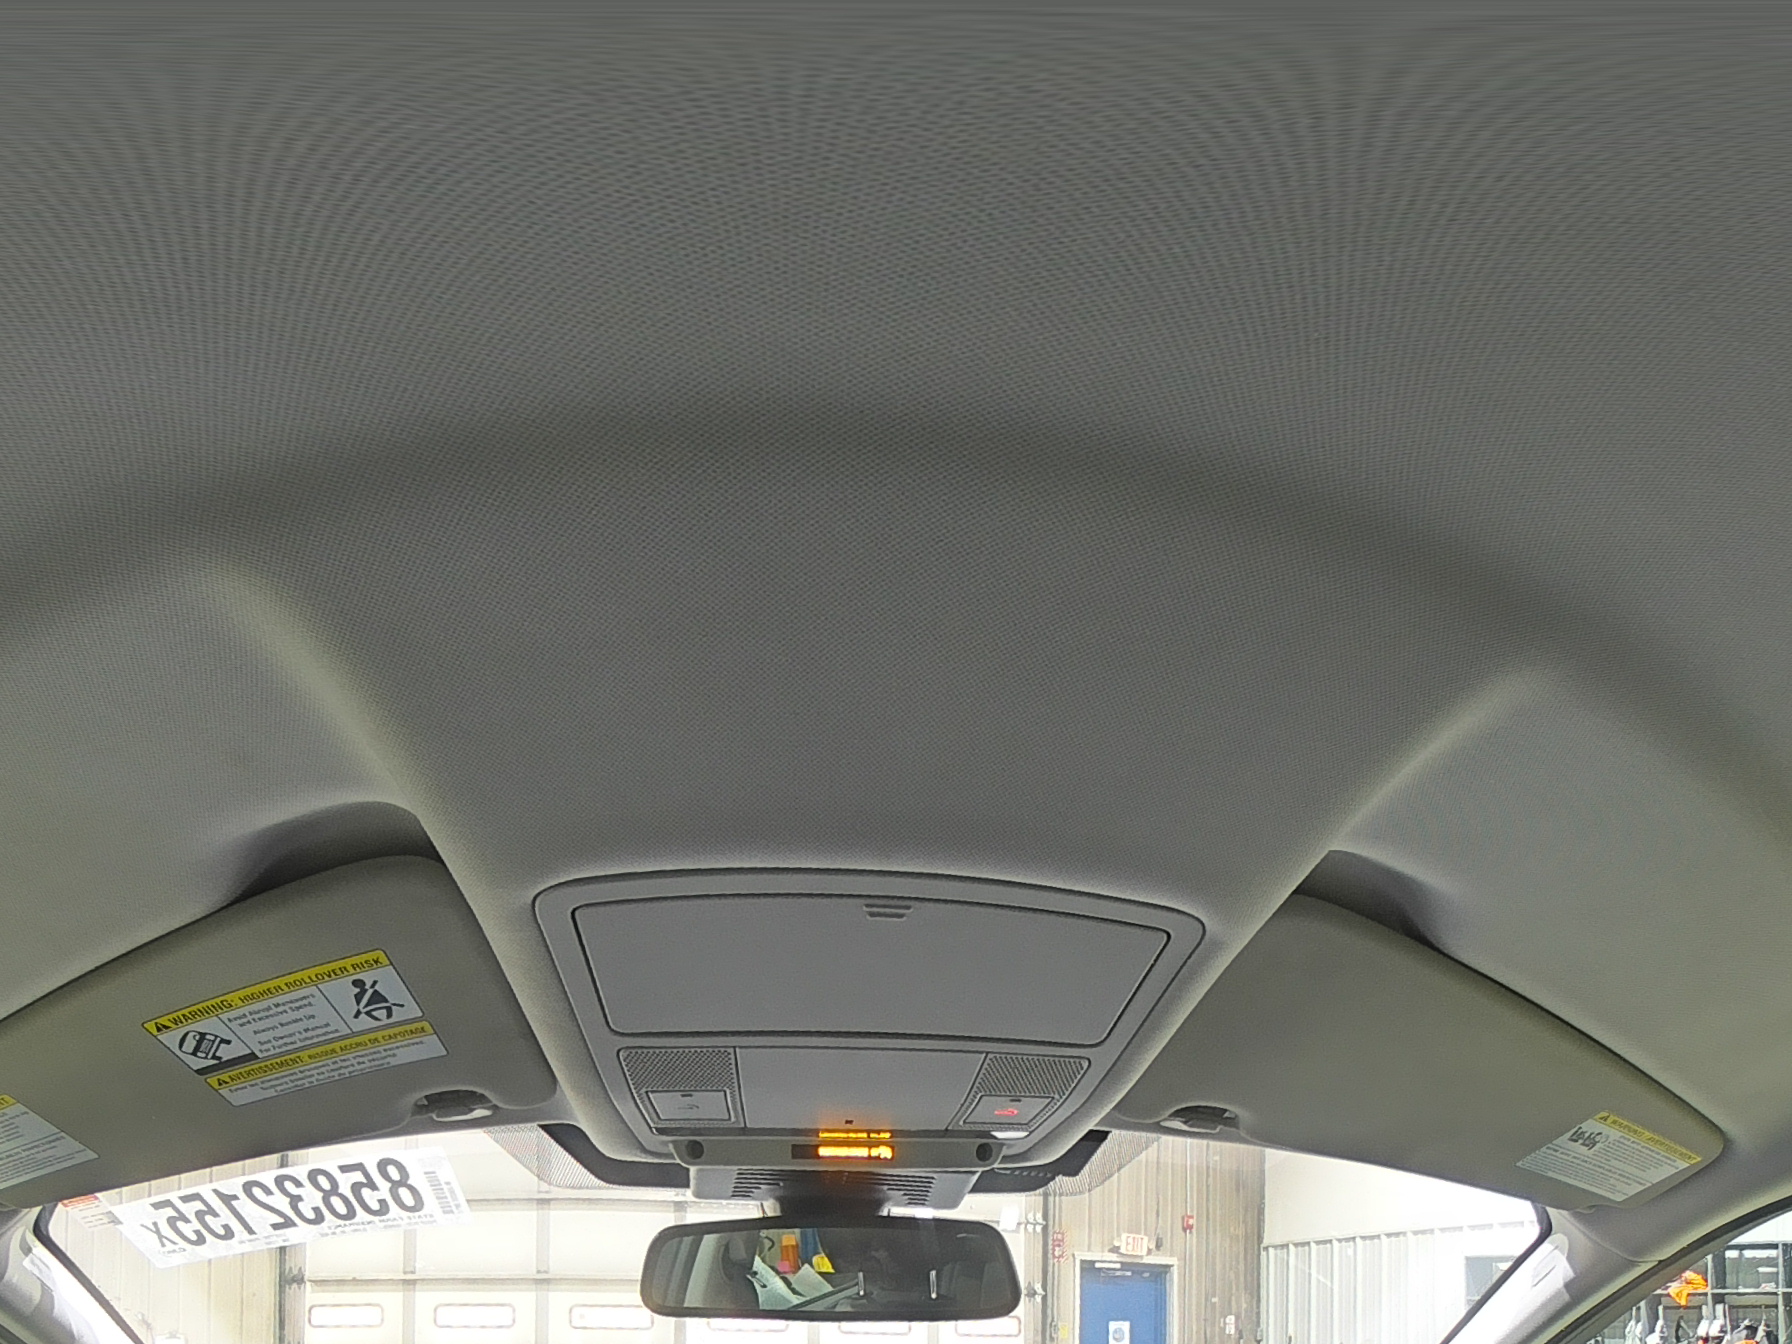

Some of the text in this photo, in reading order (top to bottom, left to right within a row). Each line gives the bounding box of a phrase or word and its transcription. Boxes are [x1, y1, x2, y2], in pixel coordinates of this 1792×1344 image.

[168, 956, 383, 1027] WARNING: HIGHER ROLLOVER RISK
[1125, 1235, 1144, 1253] EXIT
